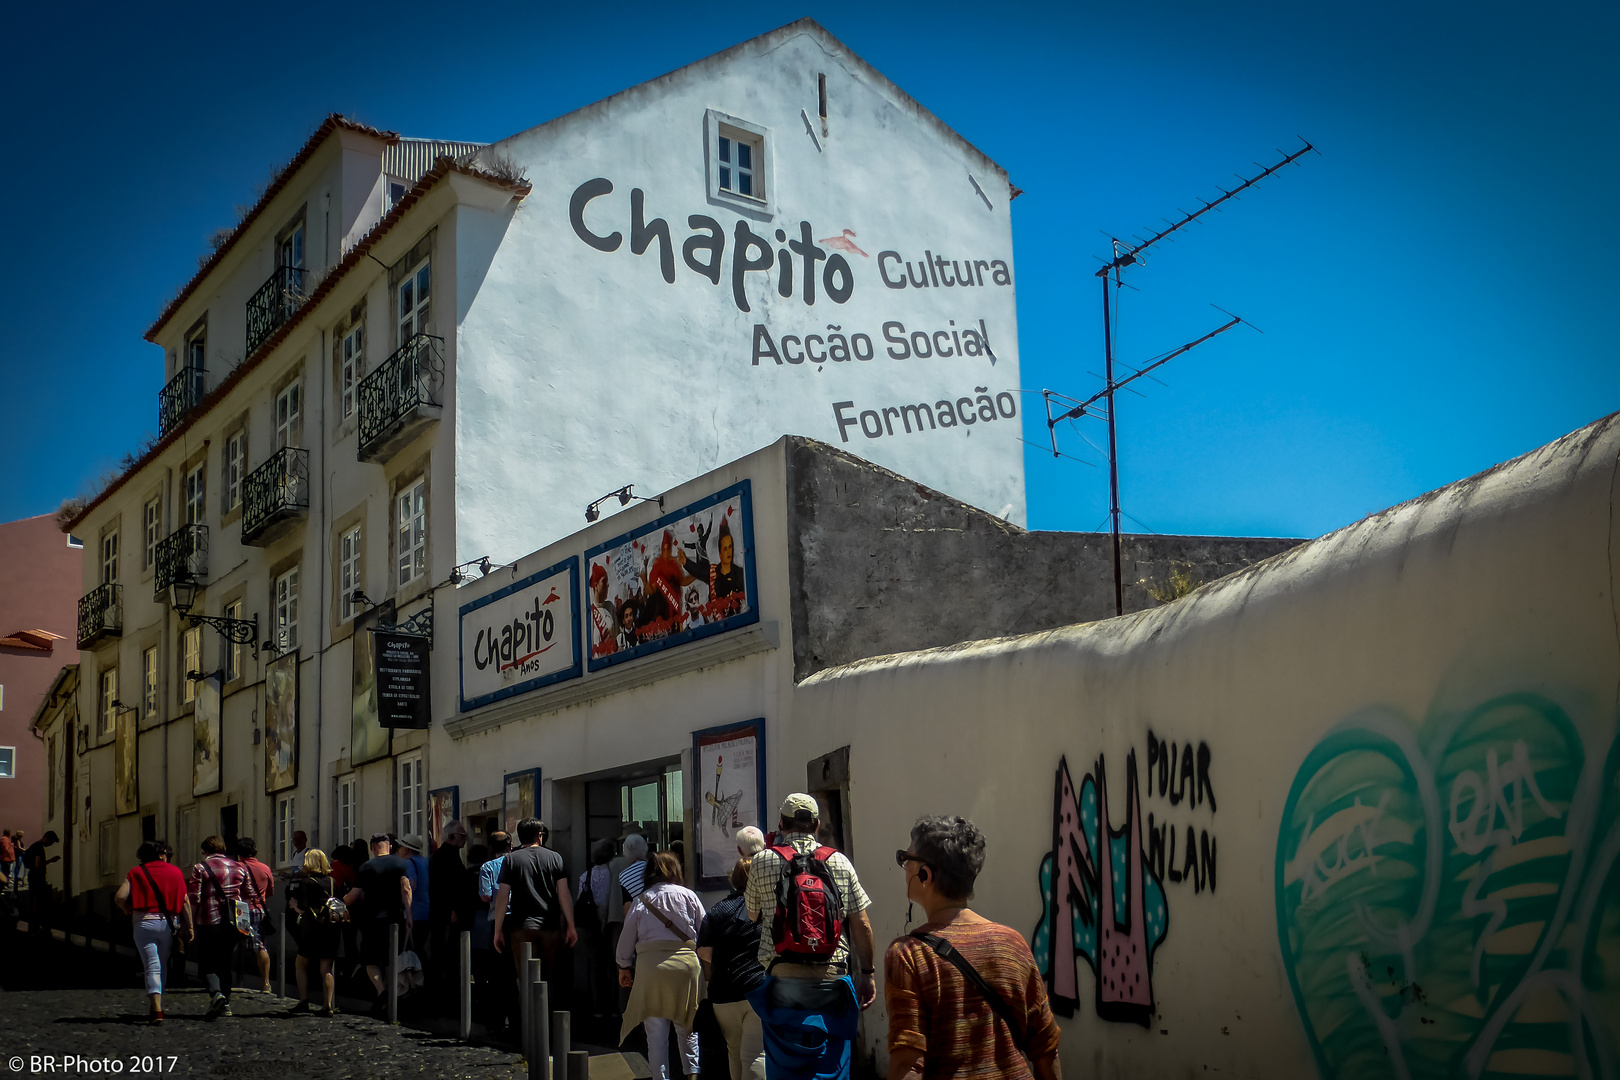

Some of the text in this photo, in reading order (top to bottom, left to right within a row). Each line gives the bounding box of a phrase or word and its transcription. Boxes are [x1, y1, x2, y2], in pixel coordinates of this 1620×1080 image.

[877, 249, 1012, 290] Cultura
[751, 319, 992, 372] Acção Social
[832, 386, 1016, 442] Formação
[1147, 729, 1217, 814] POLAR
